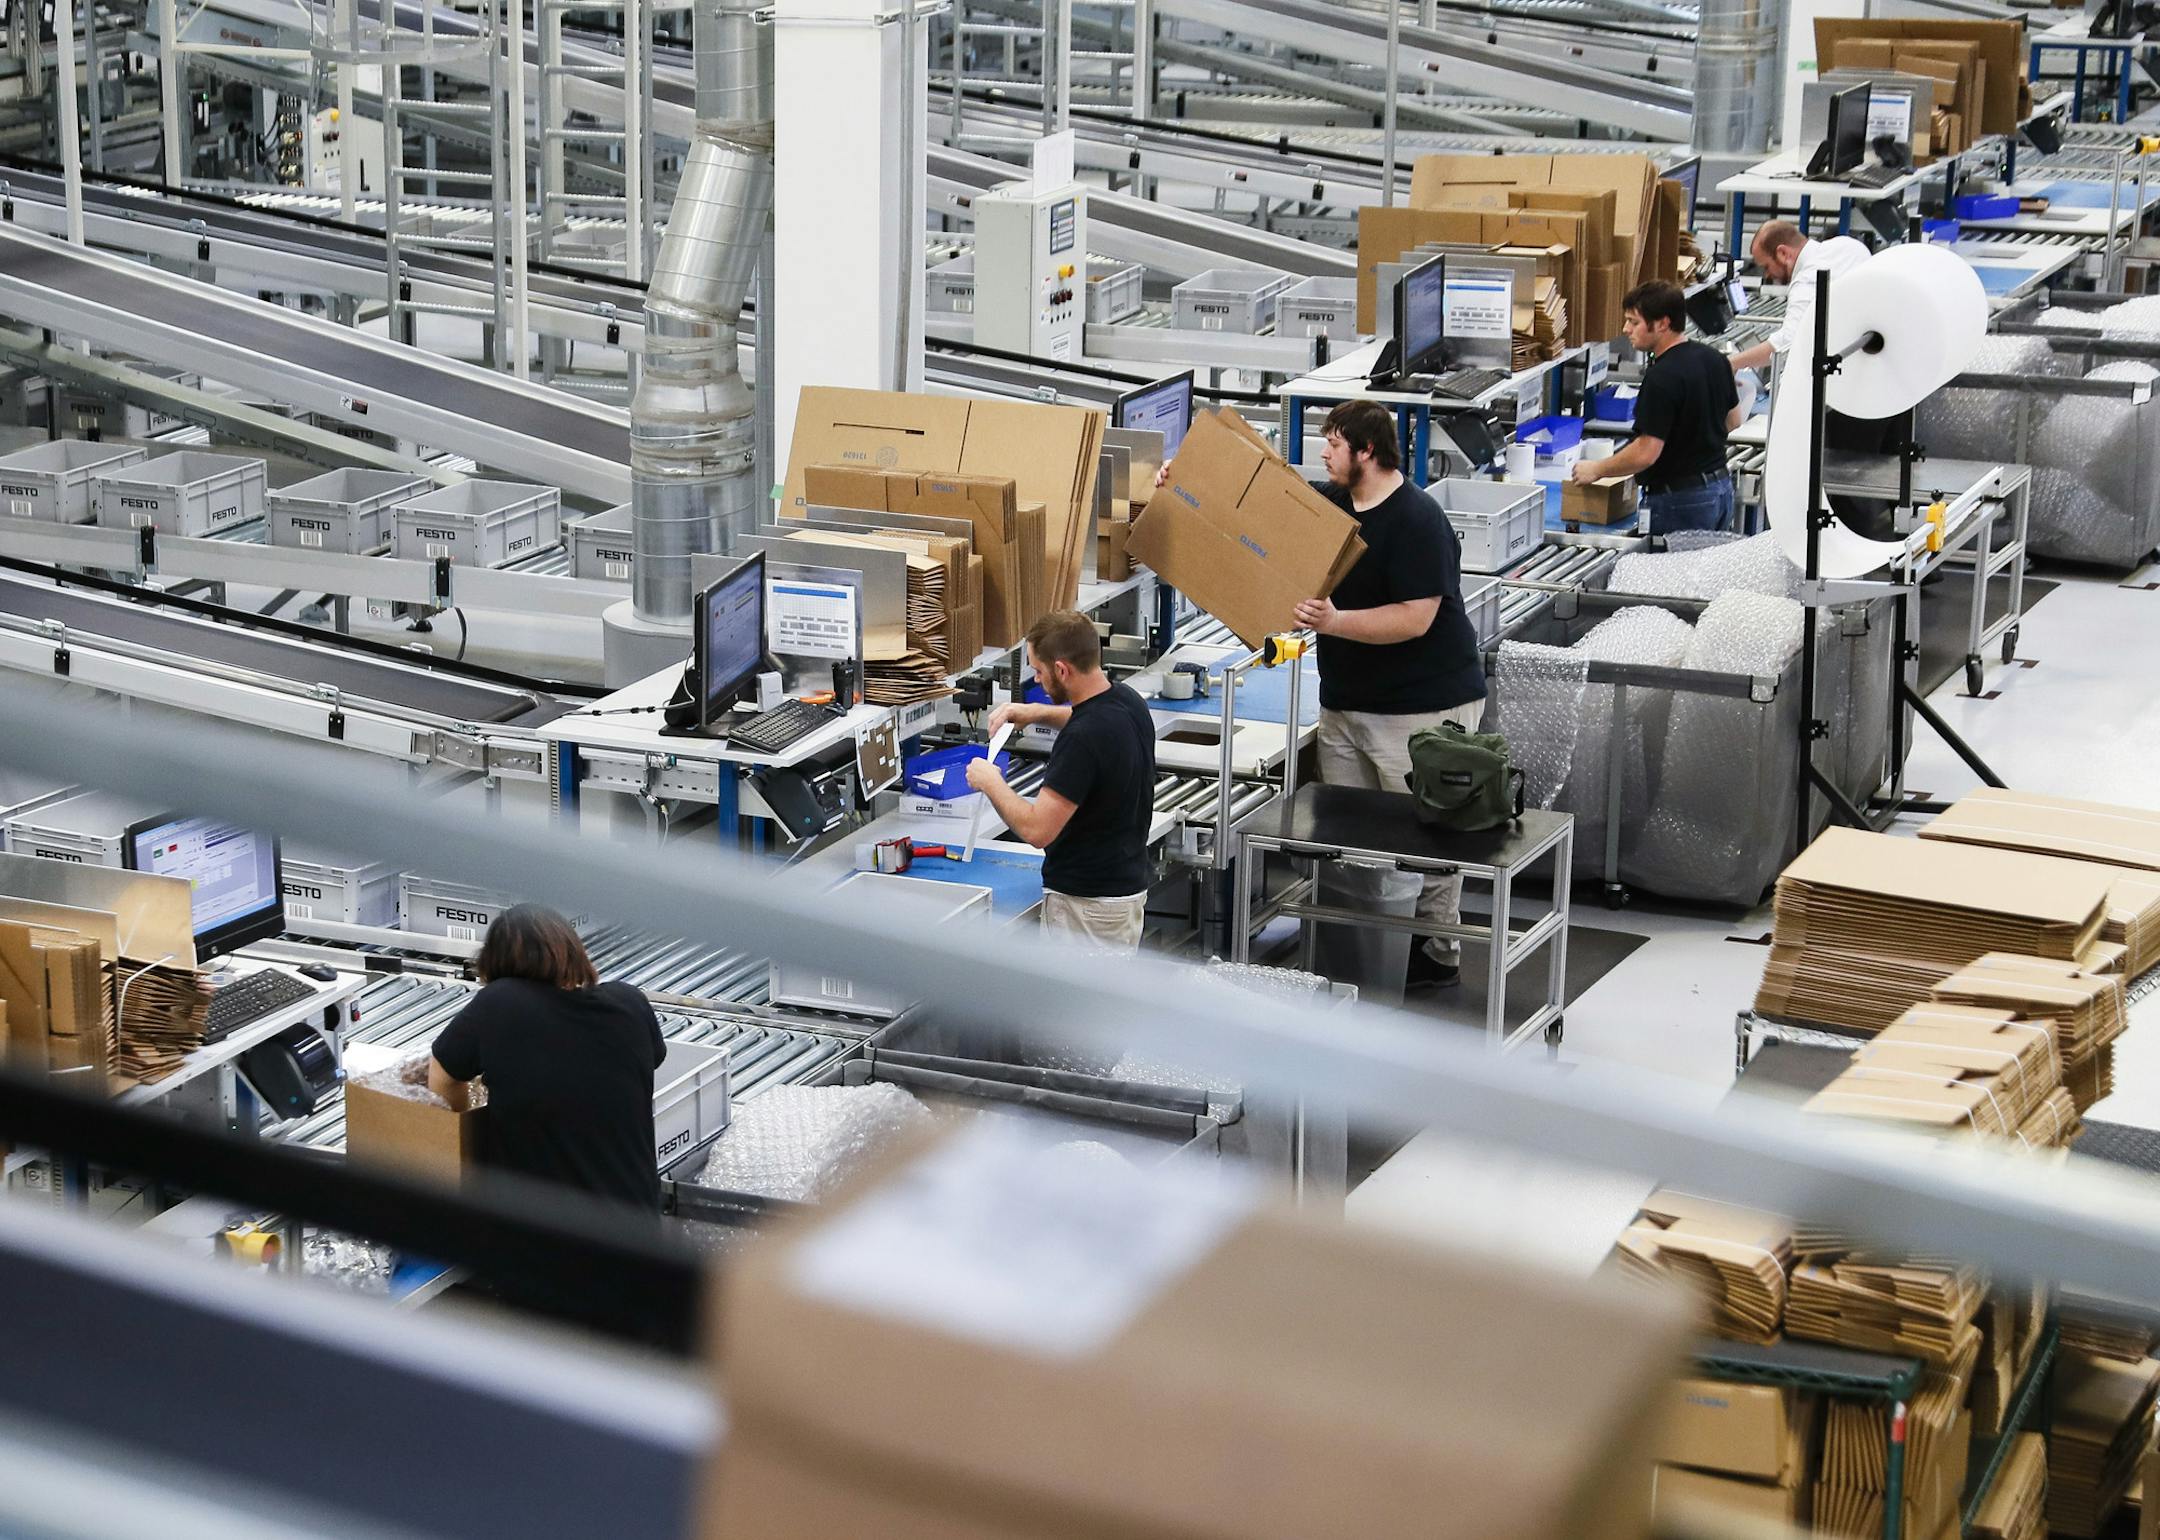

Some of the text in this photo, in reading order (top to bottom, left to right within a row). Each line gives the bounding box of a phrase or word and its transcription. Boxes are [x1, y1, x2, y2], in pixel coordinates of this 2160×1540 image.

[945, 287, 974, 295] FEST
[1194, 305, 1229, 313] FESTO
[1299, 312, 1334, 321] FESTO
[70, 402, 105, 414] FESTO
[2, 485, 38, 496] FESTO
[121, 498, 158, 509] FESTO
[212, 506, 237, 521] FESTO
[292, 518, 330, 530] FESTO
[416, 528, 455, 540] FESTO
[508, 536, 532, 551] FESTO
[282, 883, 321, 899] ESTO
[436, 906, 488, 925] FESTO
[658, 1129, 689, 1159] FESTO
